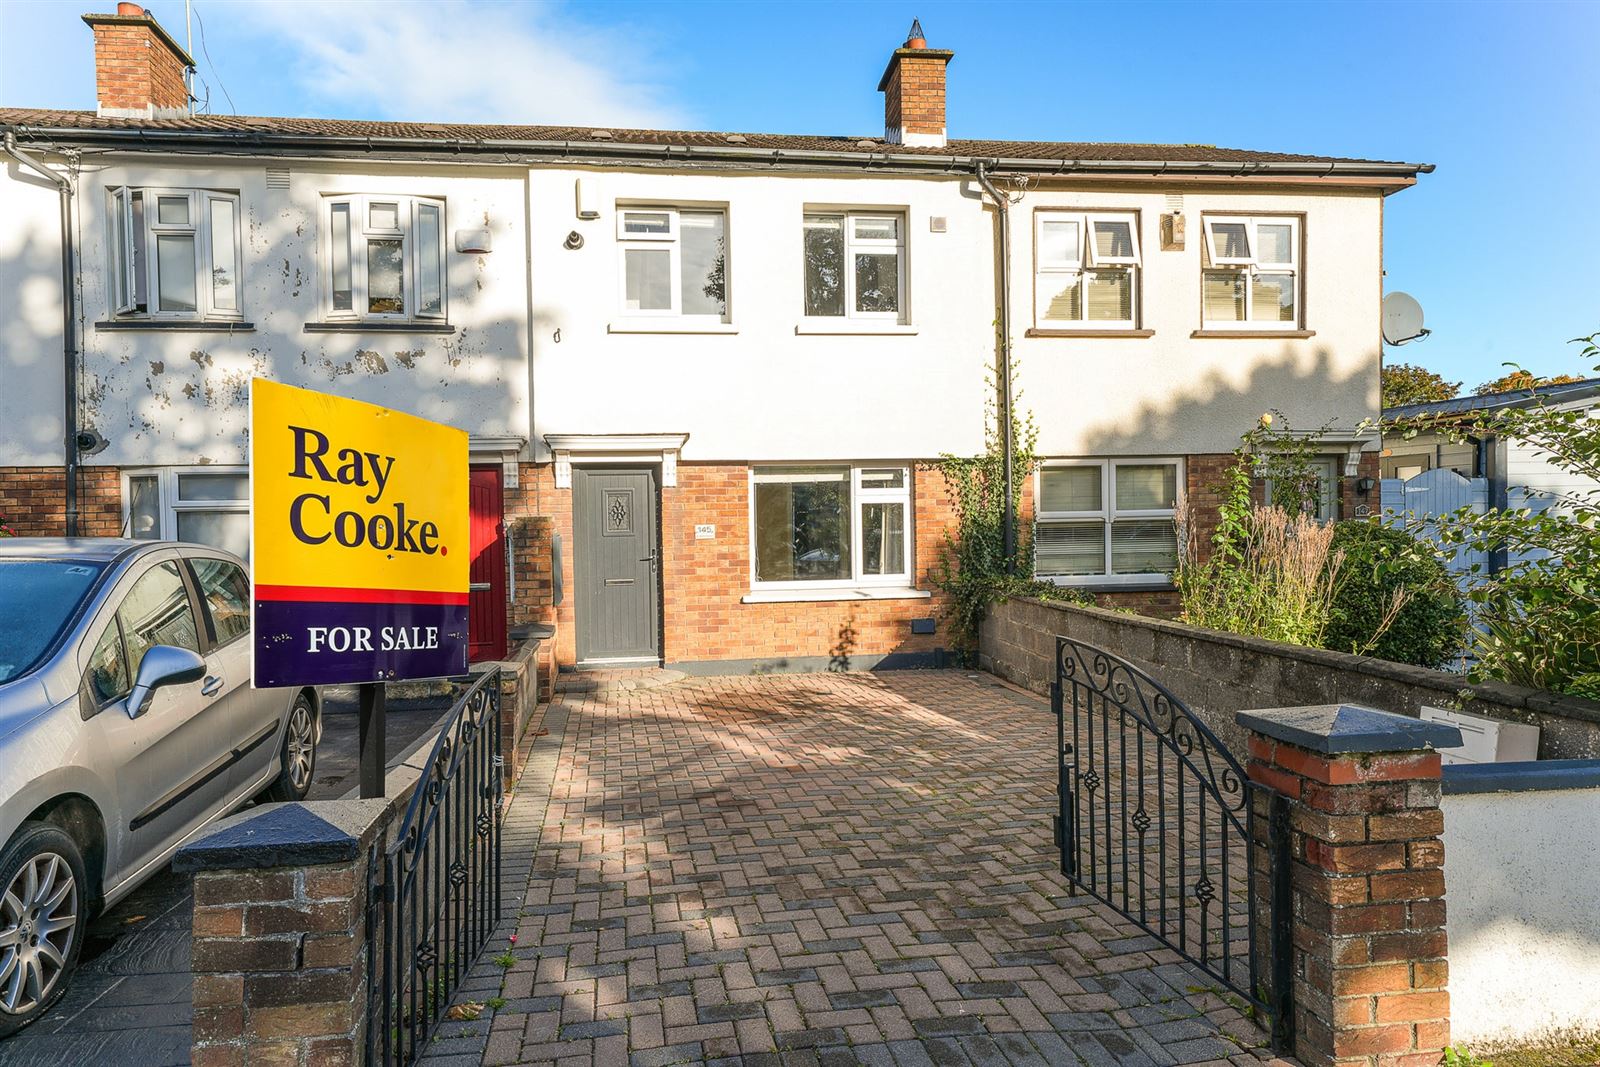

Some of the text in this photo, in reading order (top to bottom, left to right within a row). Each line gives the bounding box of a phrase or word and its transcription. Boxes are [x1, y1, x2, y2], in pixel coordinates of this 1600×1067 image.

[288, 425, 395, 504] Ray
[307, 627, 439, 652] FOR SALE
